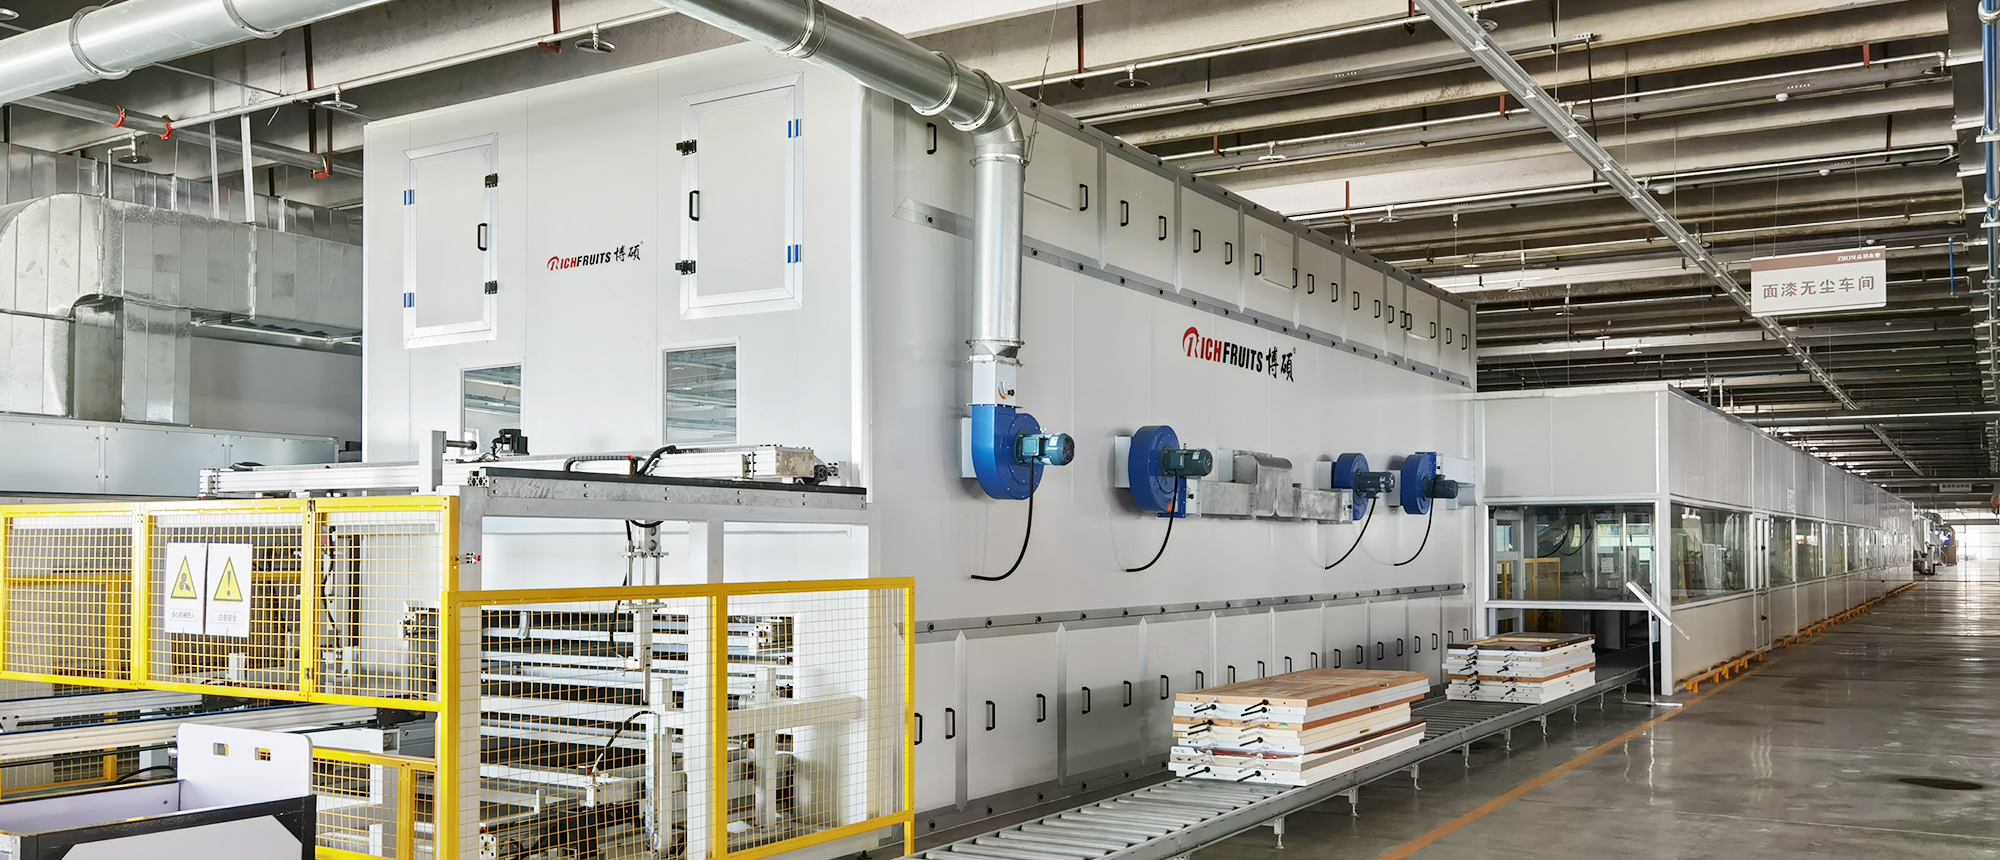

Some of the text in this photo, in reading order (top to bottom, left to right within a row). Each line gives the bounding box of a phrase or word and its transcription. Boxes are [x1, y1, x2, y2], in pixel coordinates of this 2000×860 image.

[546, 251, 611, 271] RICHFRUITS
[1762, 275, 1875, 299] 面漆无尘车间
[1182, 326, 1264, 373] RICHFRUITS
[217, 613, 238, 622] 注意安全
